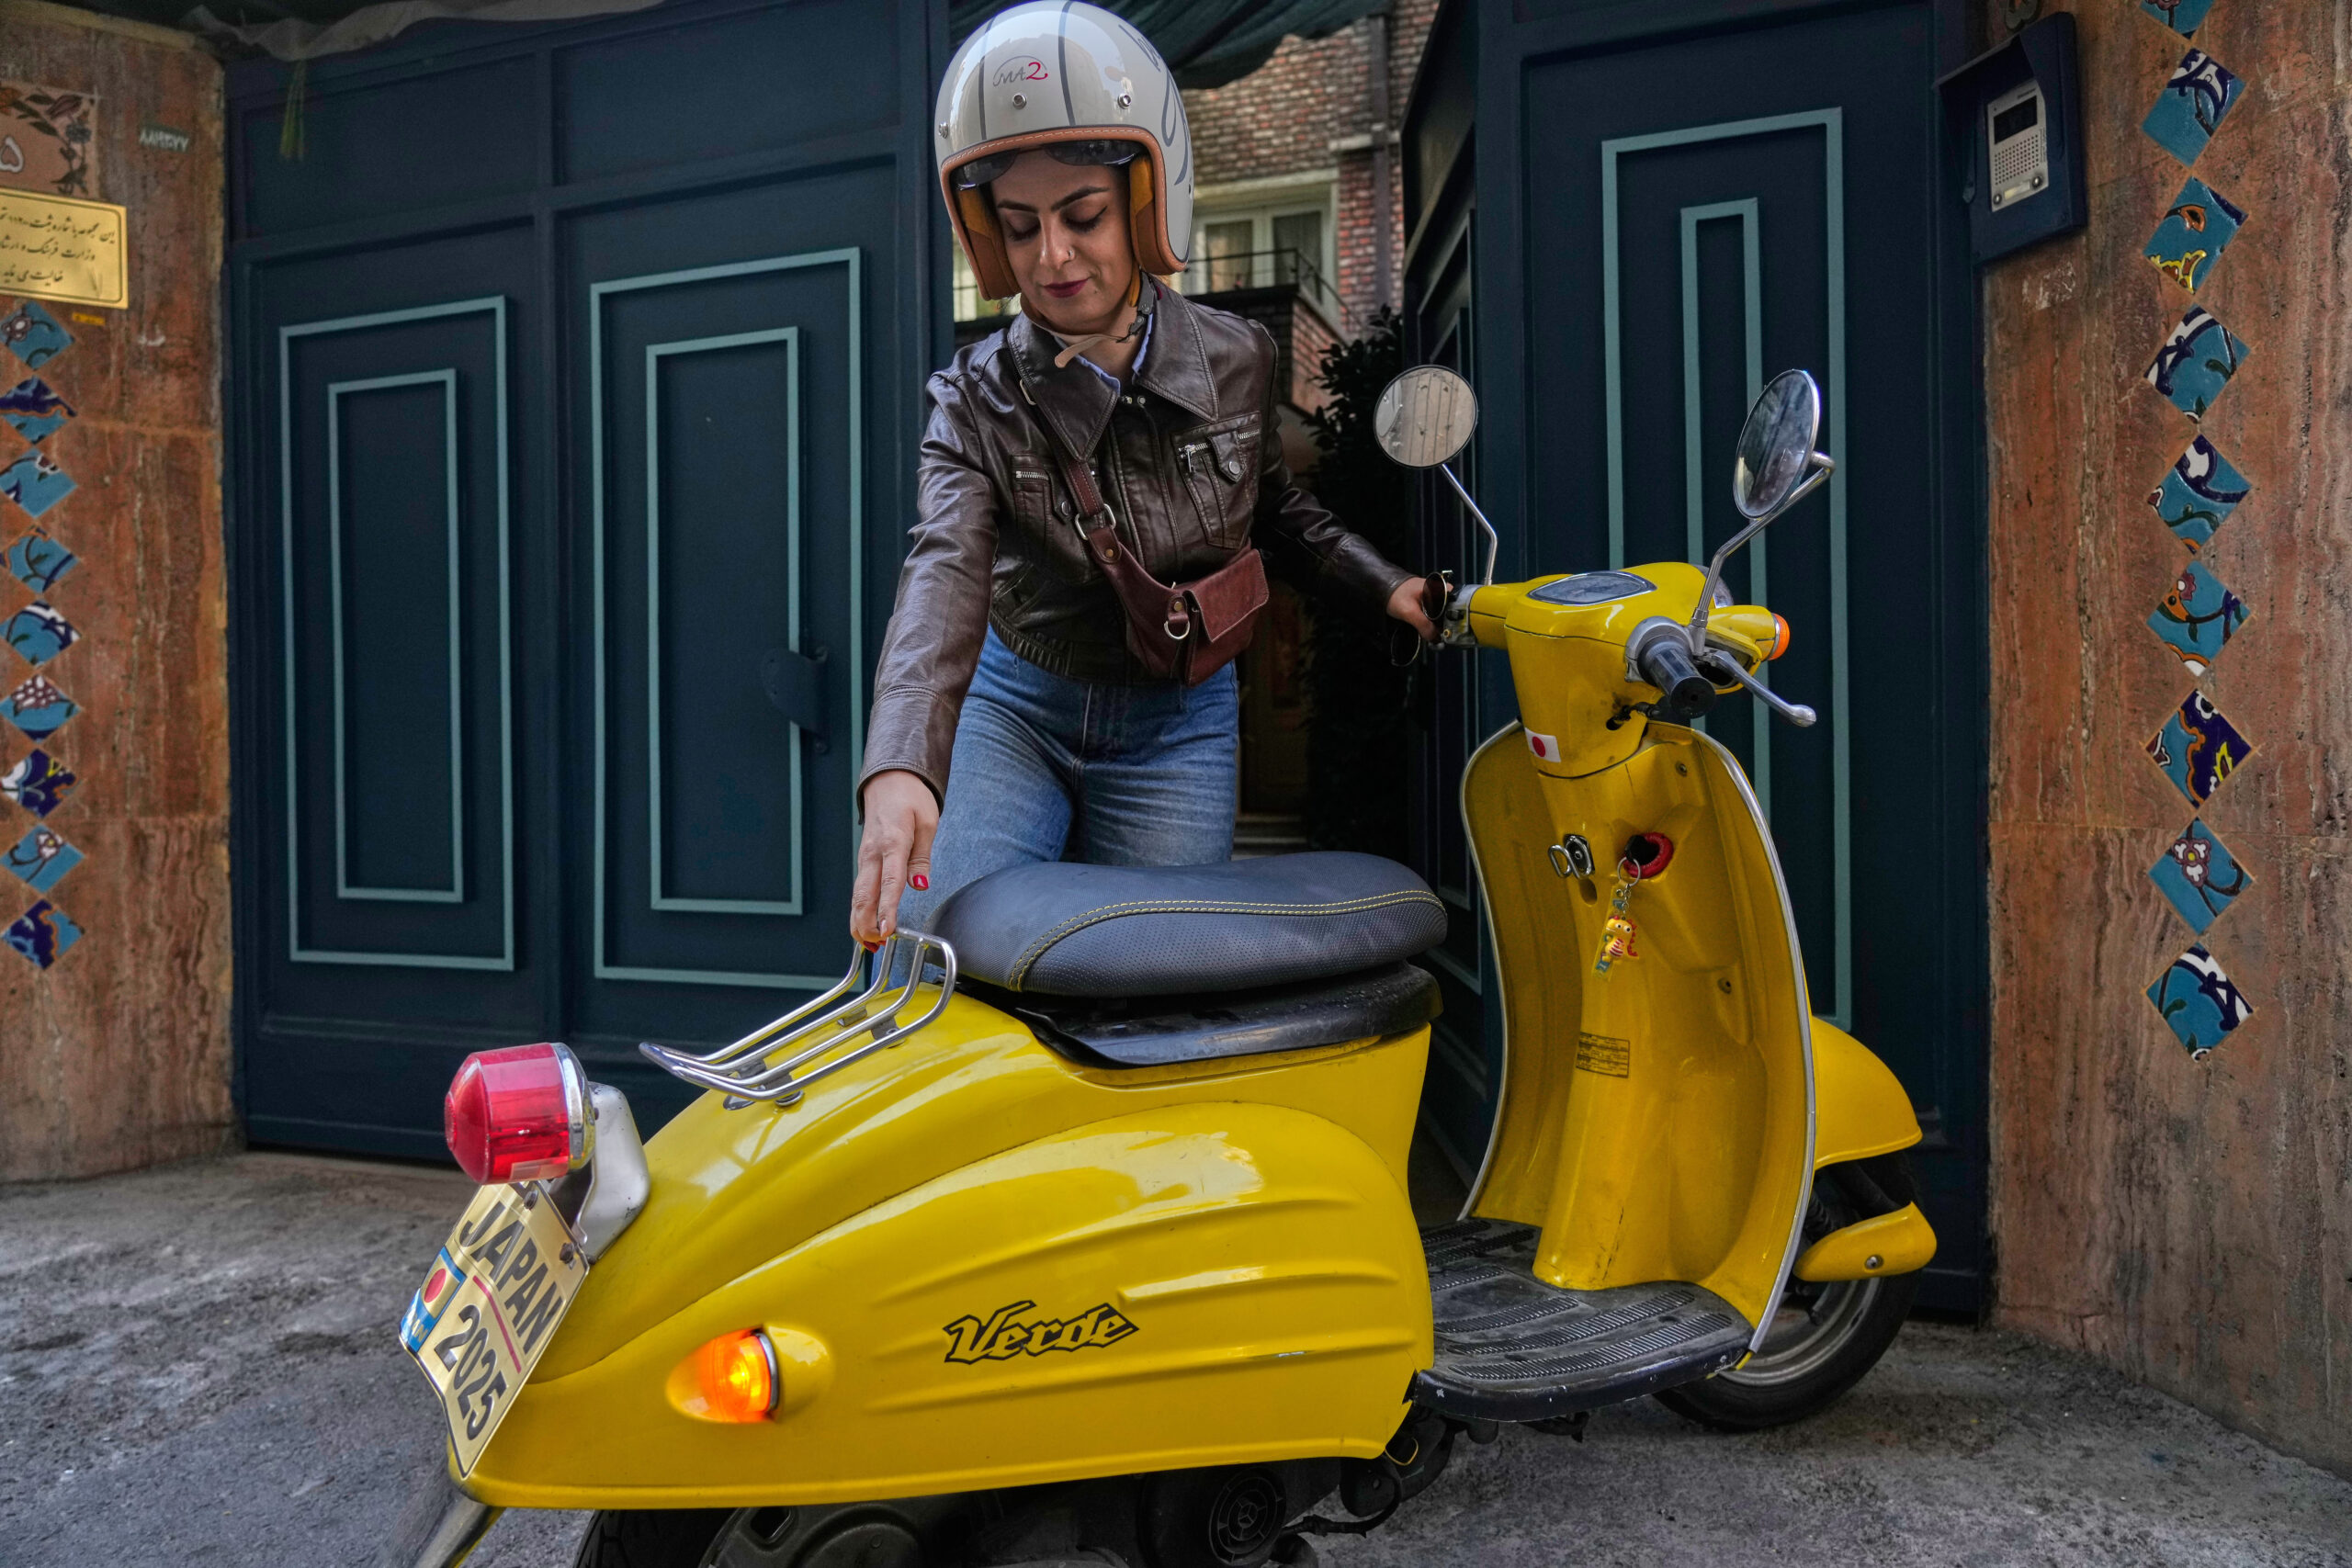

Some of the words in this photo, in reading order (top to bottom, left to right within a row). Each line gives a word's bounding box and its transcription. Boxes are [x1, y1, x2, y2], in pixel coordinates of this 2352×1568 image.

[27, 236, 59, 259] فرهنگ
[61, 248, 96, 261] وزارت
[99, 230, 116, 244] این
[458, 1200, 565, 1356] JAPAN
[942, 1299, 1140, 1366] Verde
[434, 1303, 508, 1442] 2025
